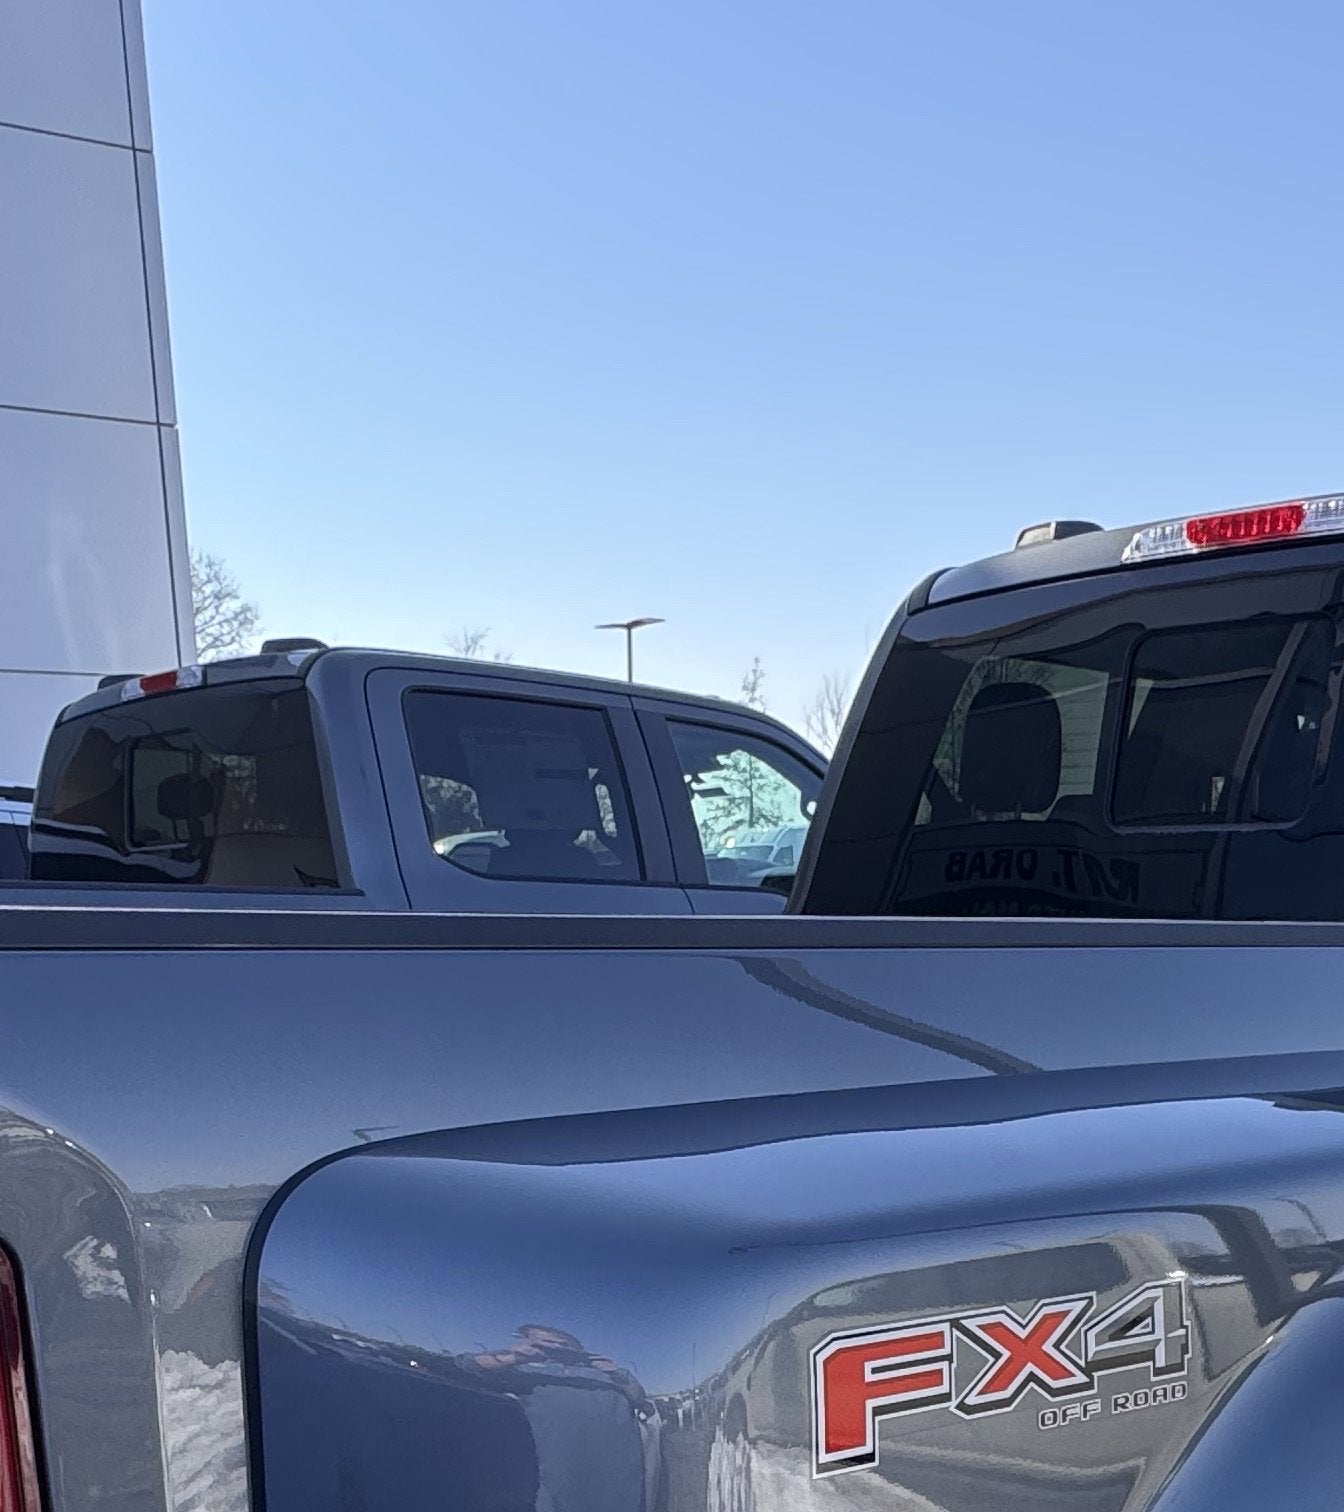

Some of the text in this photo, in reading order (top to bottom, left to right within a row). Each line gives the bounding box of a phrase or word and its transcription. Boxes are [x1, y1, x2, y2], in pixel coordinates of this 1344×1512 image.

[811, 1279, 1193, 1479] FX4
[1038, 1381, 1188, 1430] OFF ROAD
